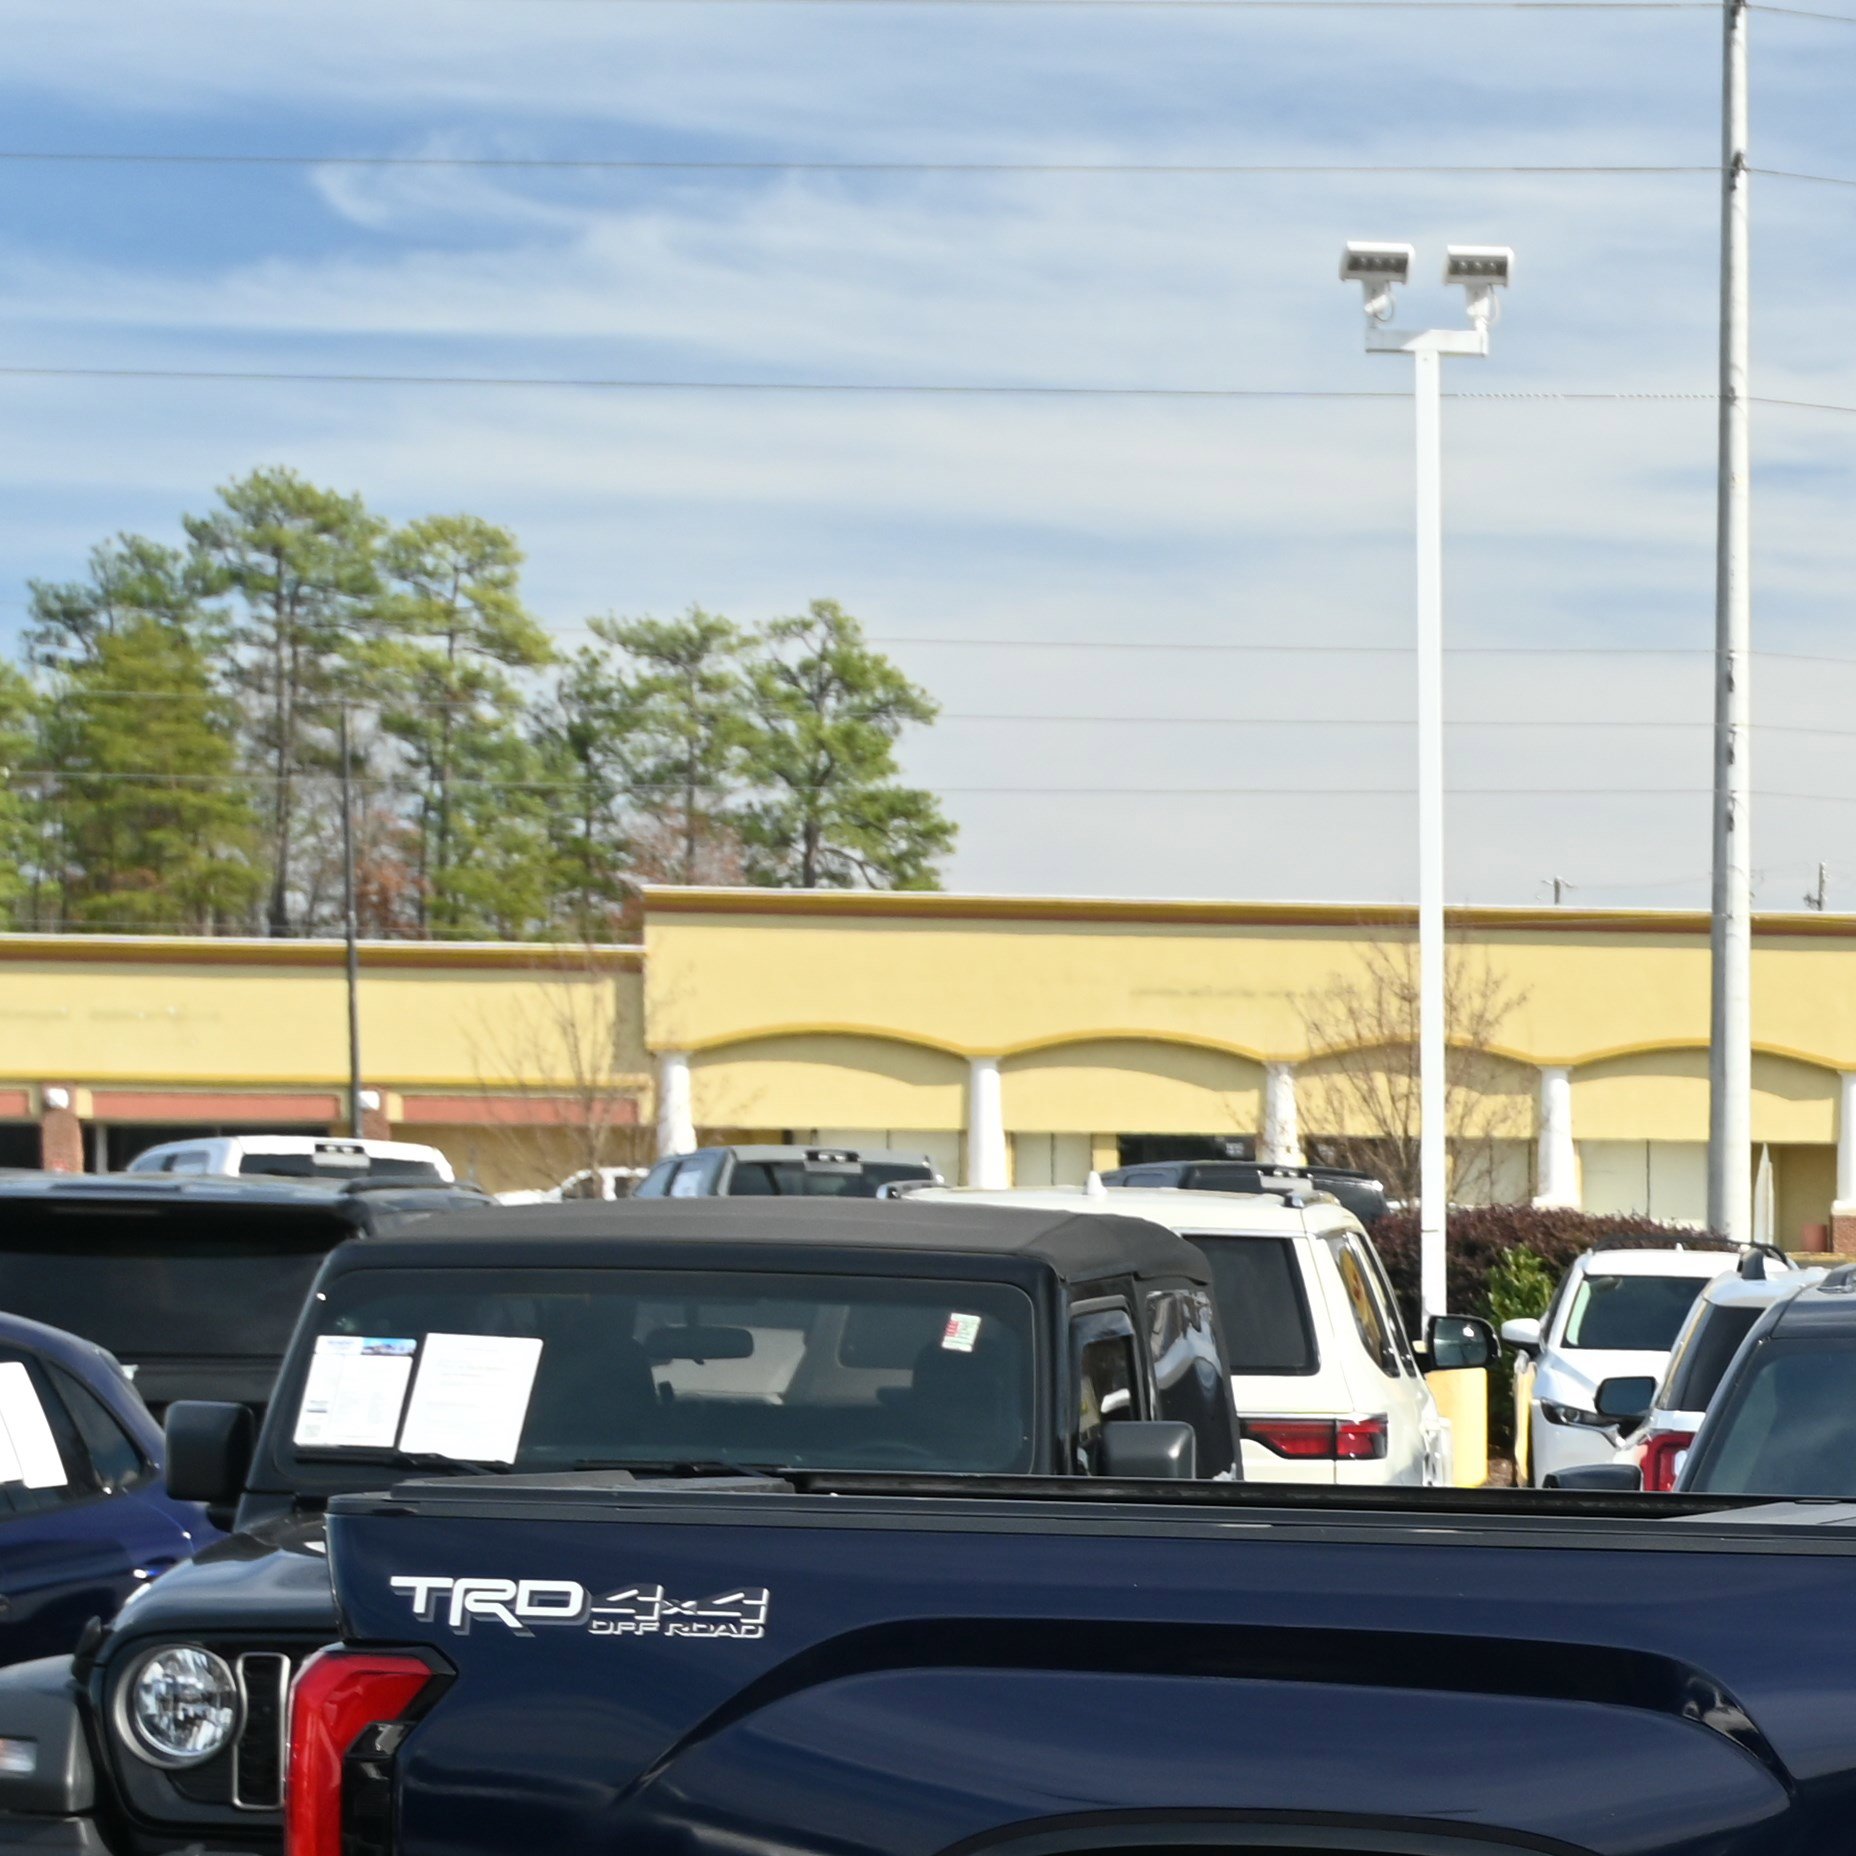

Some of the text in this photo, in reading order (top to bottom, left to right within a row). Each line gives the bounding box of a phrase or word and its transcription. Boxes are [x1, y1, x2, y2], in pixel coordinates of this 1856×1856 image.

[390, 1576, 588, 1633] TRD
[588, 1620, 765, 1639] OFF ROAD
